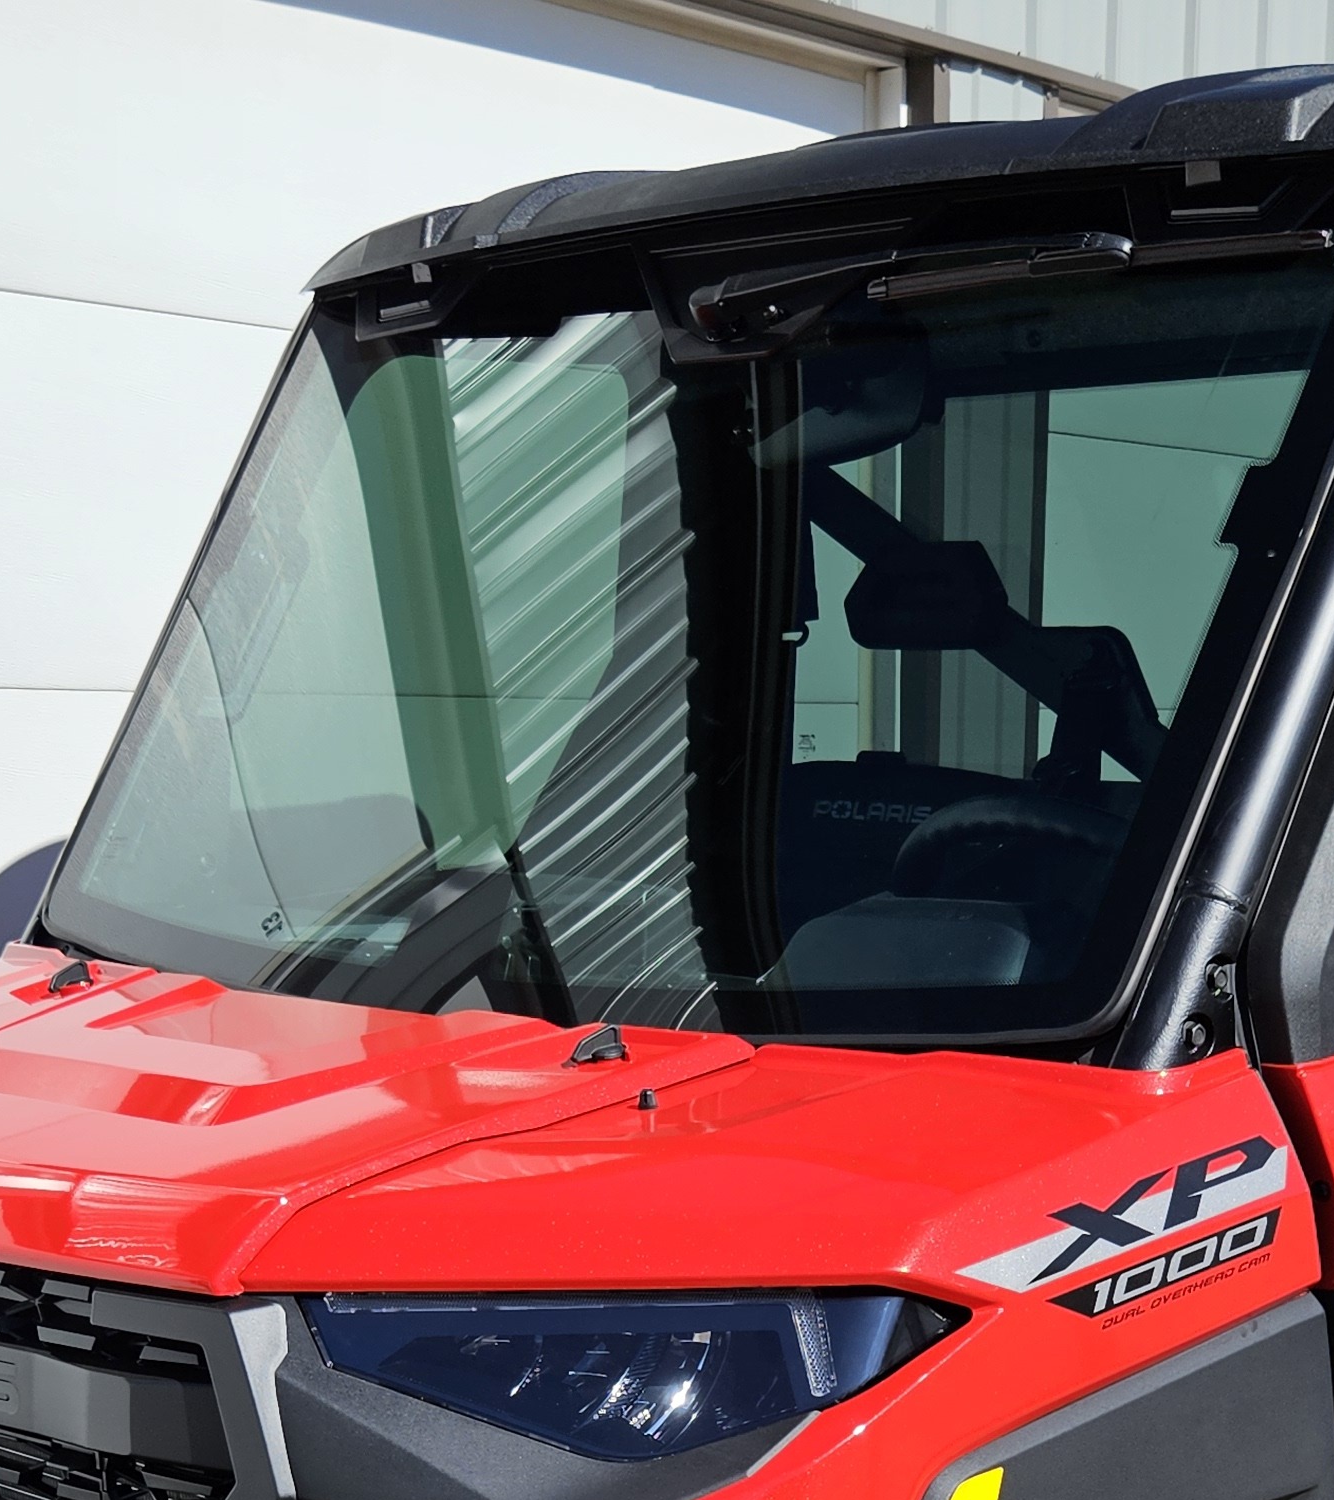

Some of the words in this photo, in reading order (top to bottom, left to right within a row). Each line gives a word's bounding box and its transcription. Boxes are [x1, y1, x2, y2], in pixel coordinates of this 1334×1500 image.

[813, 800, 932, 823] POLARIS
[1026, 1134, 1276, 1285] XP
[1092, 1216, 1269, 1313] 1000
[1102, 1305, 1145, 1330] DUAL
[1150, 1267, 1235, 1309] OVERHEAD
[1238, 1252, 1271, 1273] CAM
